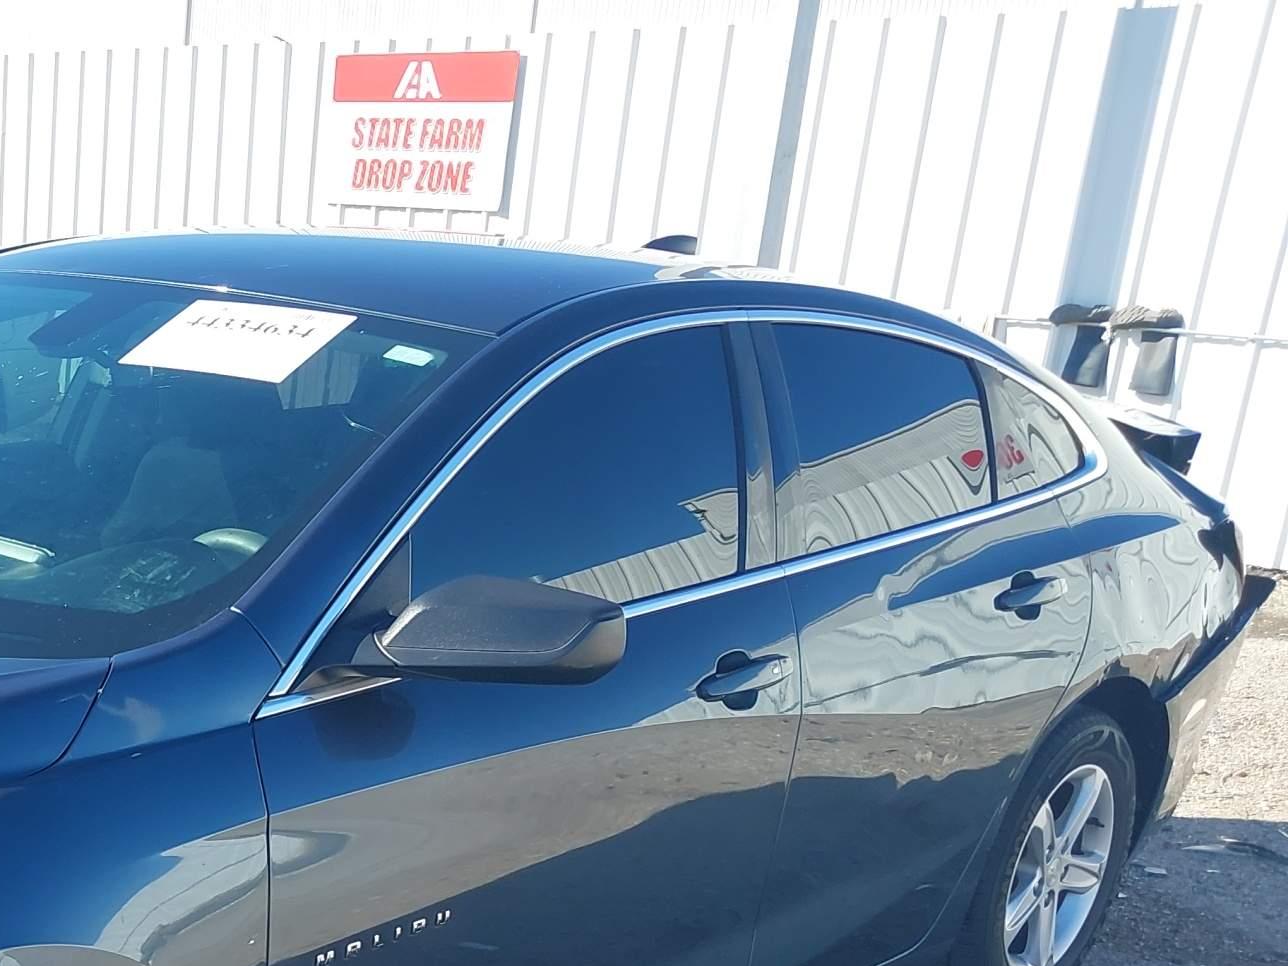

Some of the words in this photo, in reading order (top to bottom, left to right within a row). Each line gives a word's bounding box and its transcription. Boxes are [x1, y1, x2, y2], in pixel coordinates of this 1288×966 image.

[351, 117, 416, 150] STATE
[419, 118, 486, 152] FARM
[351, 159, 412, 191] DROP
[414, 160, 475, 194] ZONE
